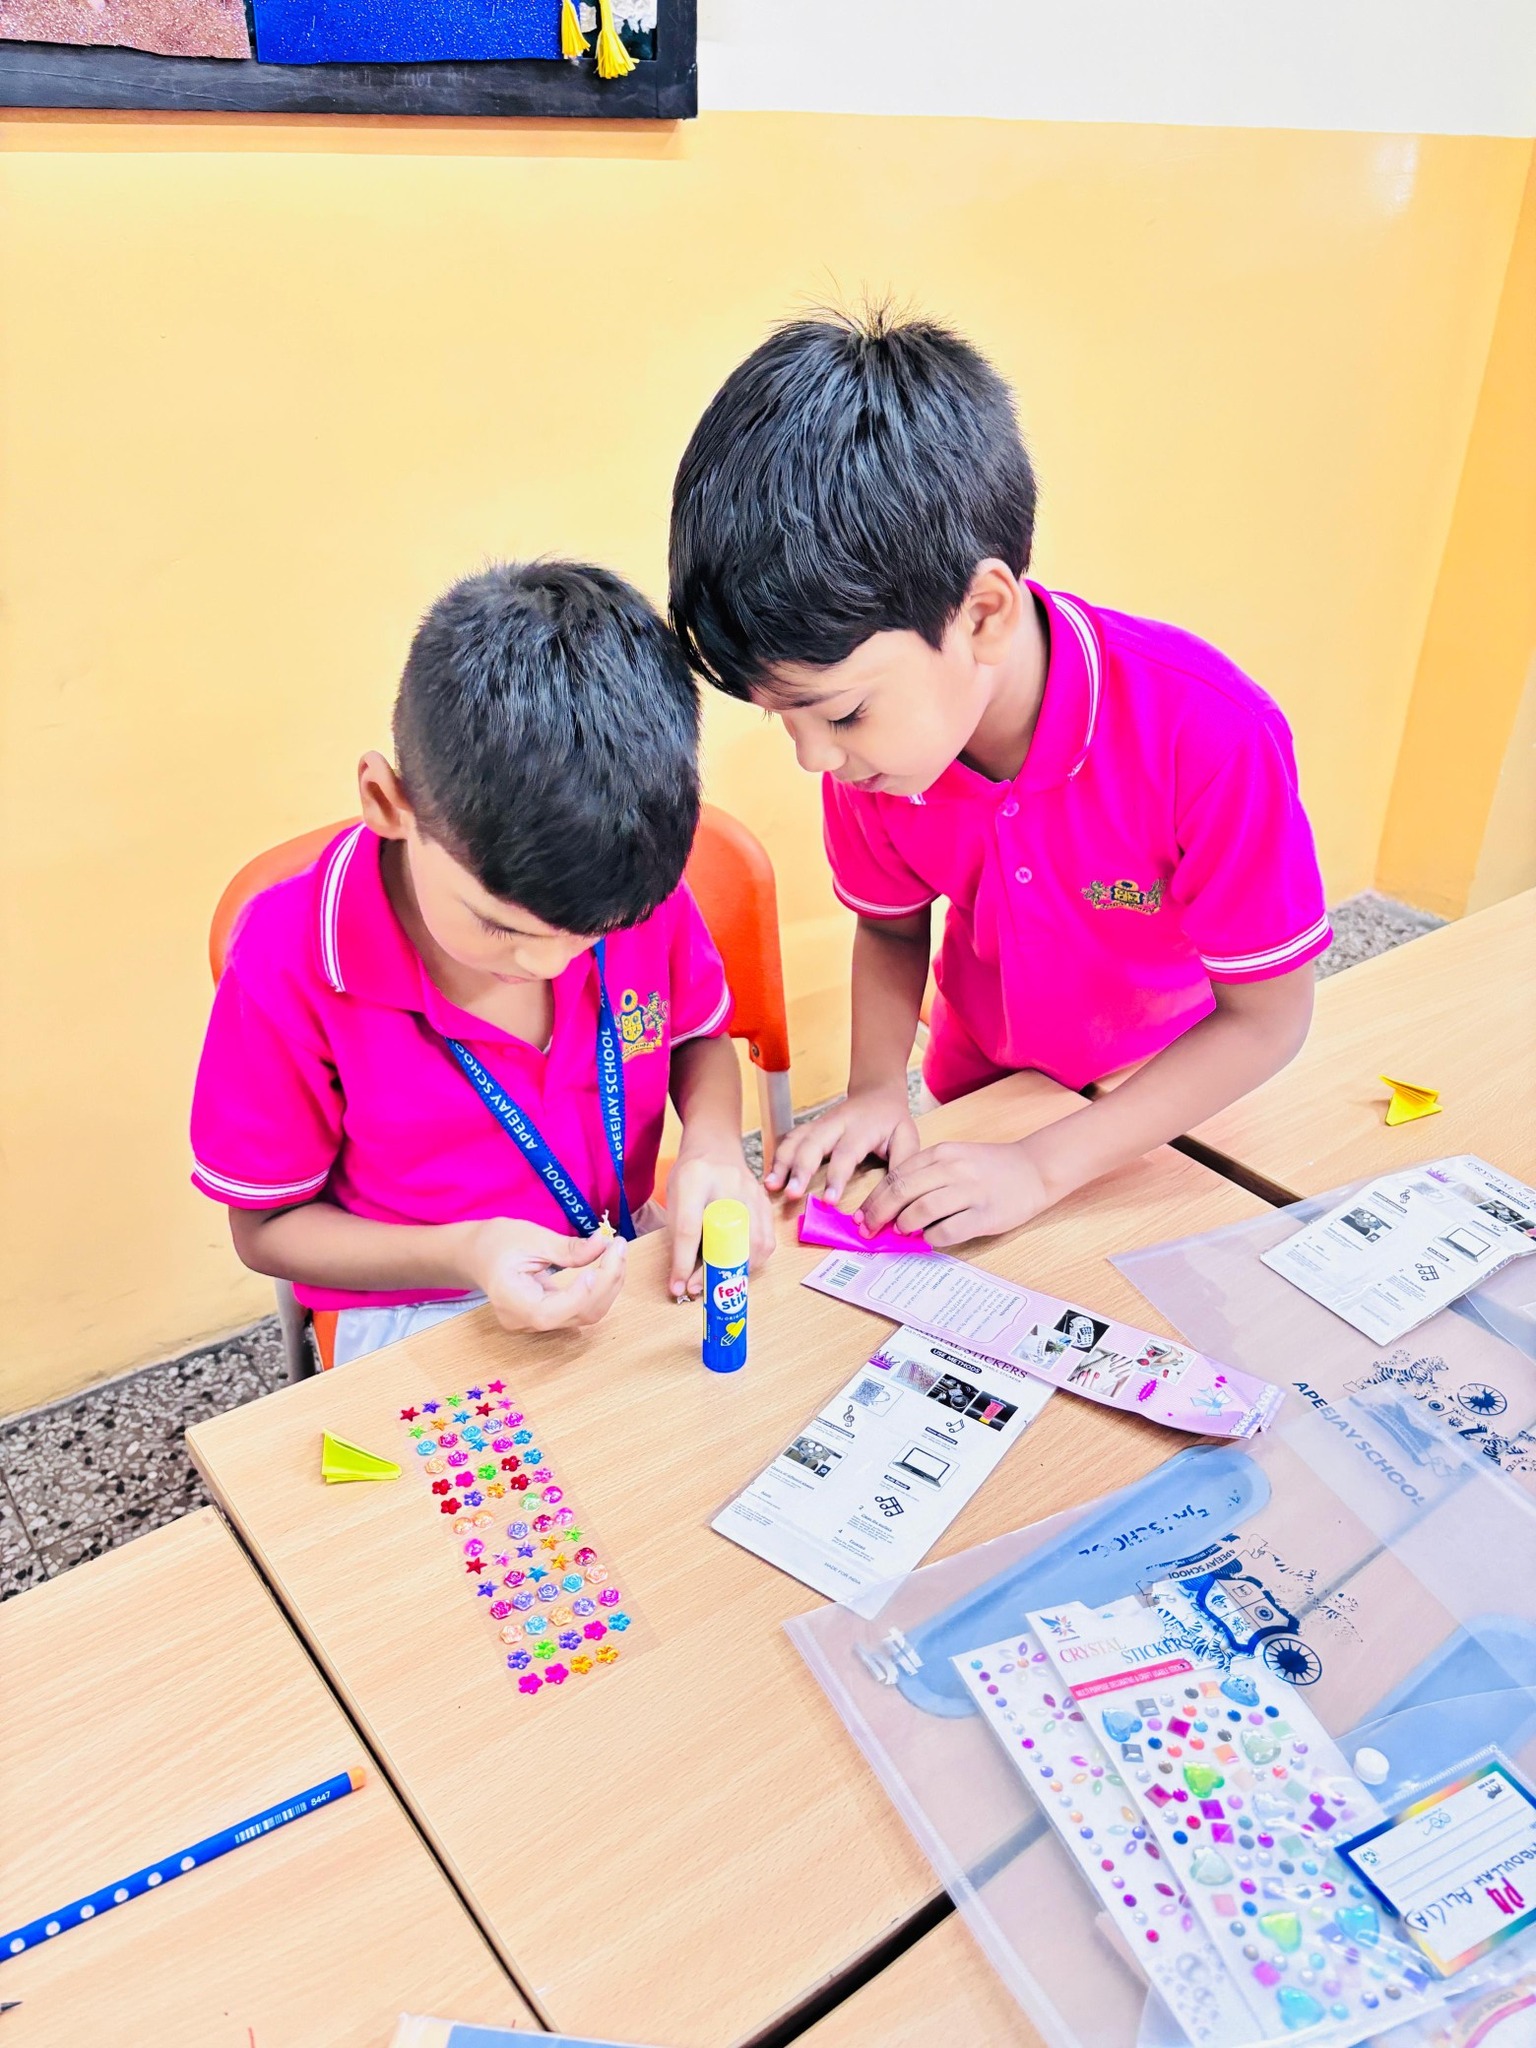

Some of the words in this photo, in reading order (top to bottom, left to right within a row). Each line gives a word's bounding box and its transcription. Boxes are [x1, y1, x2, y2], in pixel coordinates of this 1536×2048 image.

[451, 1040, 495, 1094] SCHOO
[601, 1028, 618, 1093] SCHOOL
[490, 1094, 538, 1150] APEEJAY
[606, 1097, 623, 1160] APEEJAY
[542, 1162, 583, 1214] SCHOOL
[718, 1280, 746, 1298] fevi
[721, 1291, 747, 1310] stik
[931, 1348, 946, 1358] USE
[946, 1354, 980, 1374] METHODS
[1292, 1382, 1362, 1439] APEEJAY
[1060, 1637, 1127, 1663] CRYSTAL
[1121, 1634, 1195, 1664] STICKERS
[310, 1790, 331, 1807] 8447
